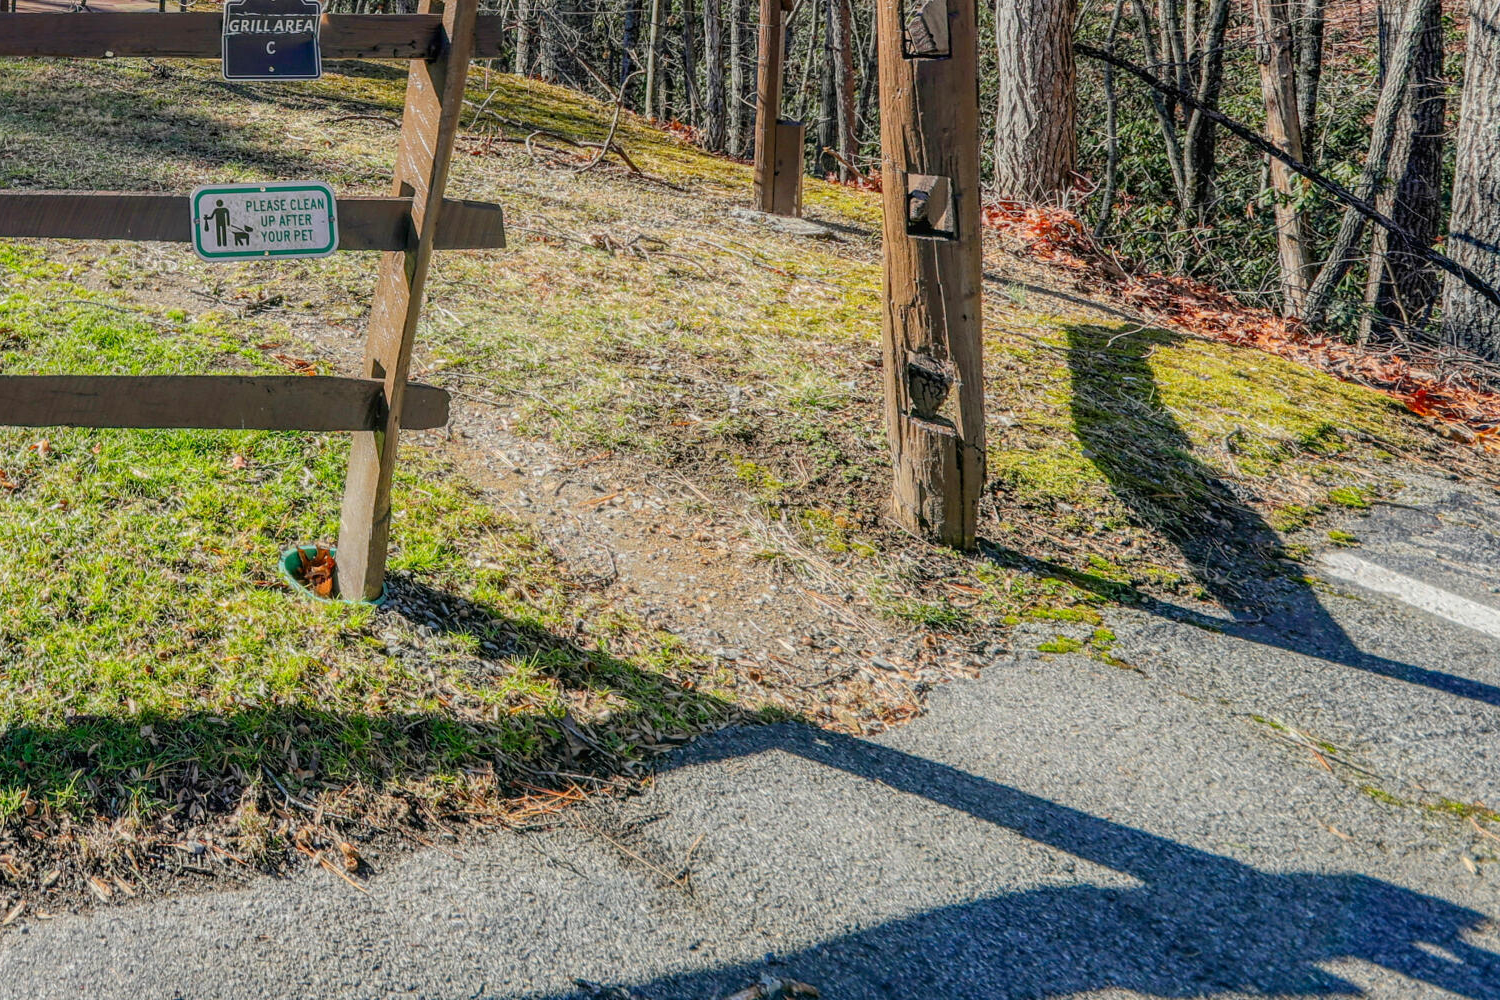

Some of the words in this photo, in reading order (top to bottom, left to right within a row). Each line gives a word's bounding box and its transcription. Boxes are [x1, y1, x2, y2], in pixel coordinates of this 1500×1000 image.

[229, 19, 270, 32] GRILL
[273, 19, 314, 32] AREA
[266, 41, 276, 55] C
[245, 199, 287, 212] PLEASE
[290, 198, 324, 210] CLEAN
[261, 215, 276, 227] UP
[279, 213, 313, 226] AFTER
[261, 230, 291, 243] YOUR
[294, 229, 313, 241] PET
